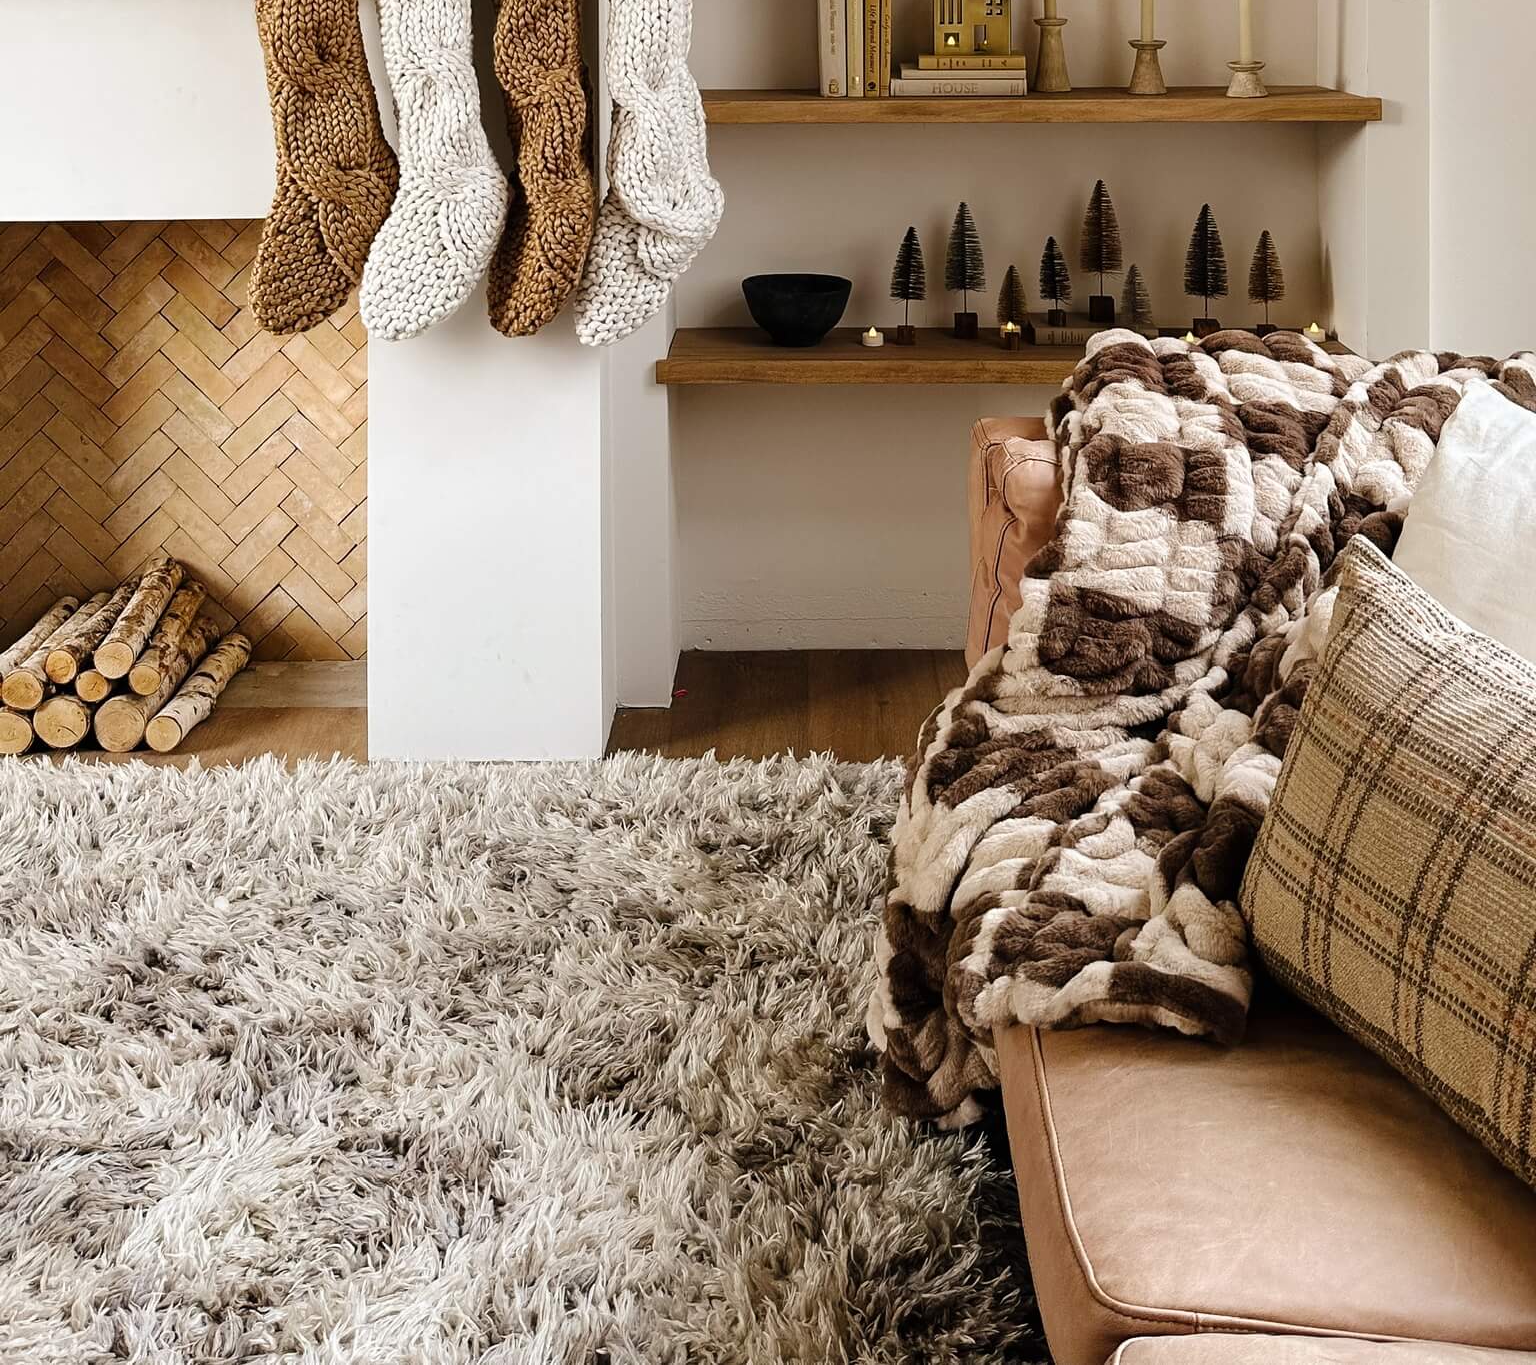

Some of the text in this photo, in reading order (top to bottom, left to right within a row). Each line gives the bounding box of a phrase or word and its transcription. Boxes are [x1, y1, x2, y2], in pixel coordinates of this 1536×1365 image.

[867, 4, 878, 74] Life Beyond Measure
[931, 82, 979, 94] HOUSE
